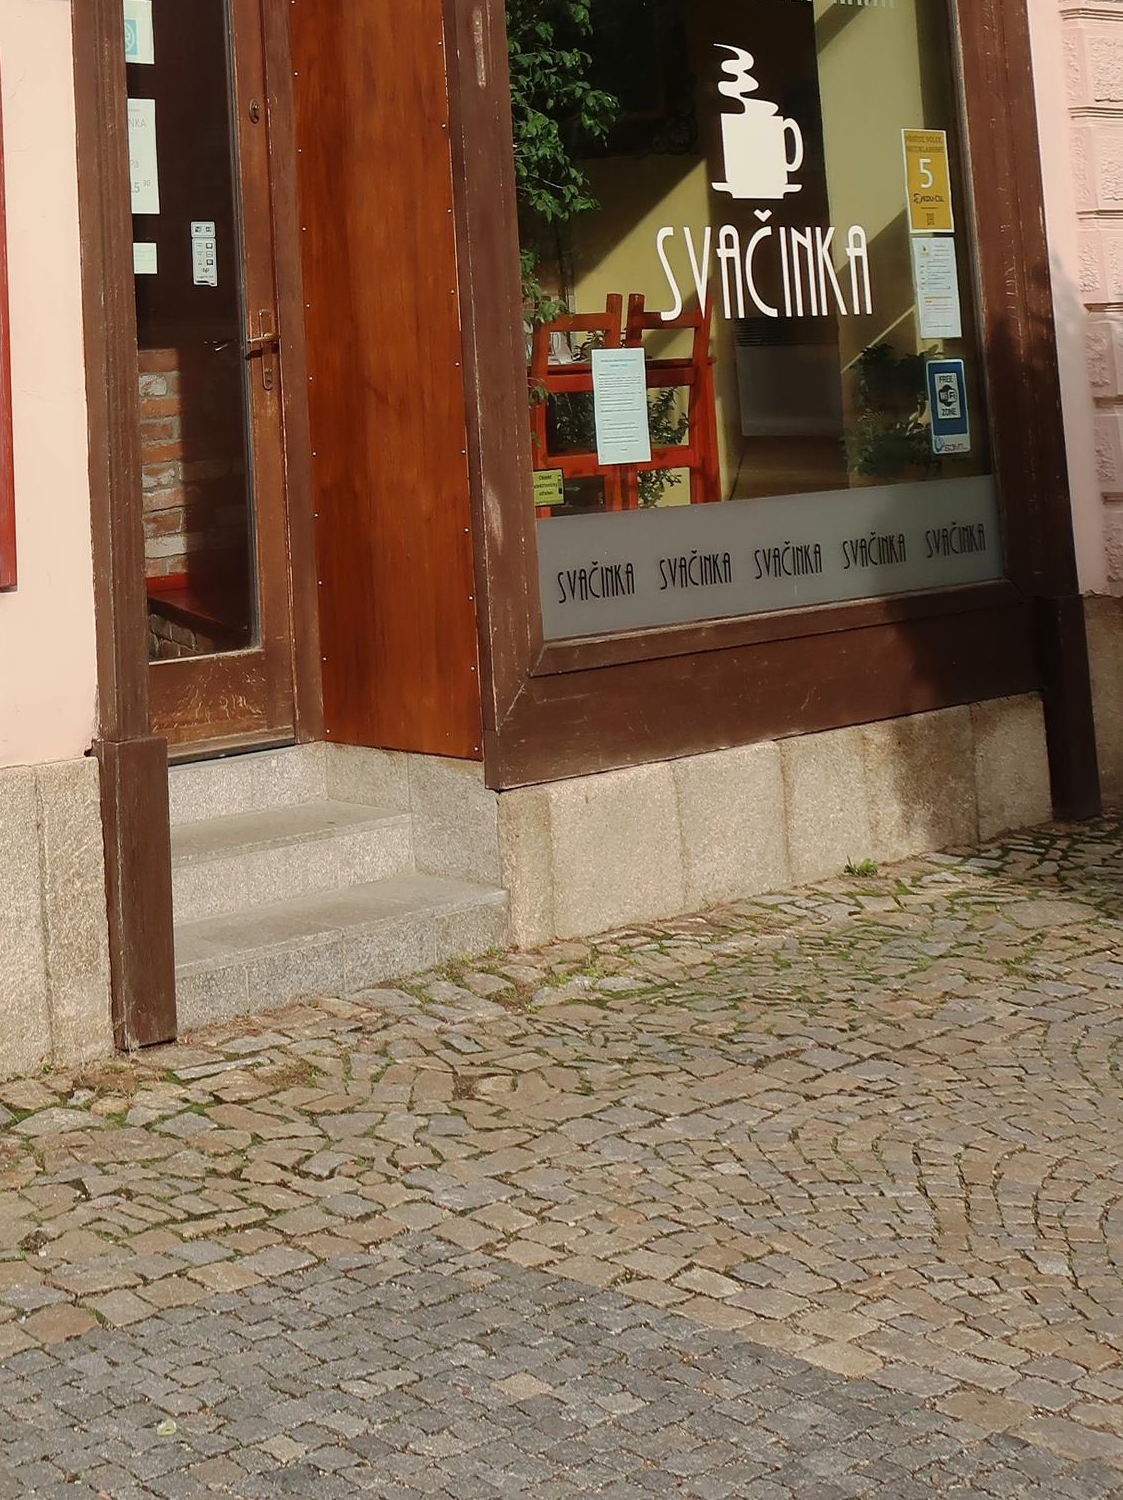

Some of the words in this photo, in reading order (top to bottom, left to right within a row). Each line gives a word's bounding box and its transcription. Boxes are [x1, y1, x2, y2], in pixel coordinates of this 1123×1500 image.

[919, 158, 934, 189] 5
[657, 209, 872, 321] SVAČINKA
[558, 561, 635, 604] SVAČINKA
[659, 550, 732, 590] SVAČINKA
[754, 541, 823, 580] SVAČINKA
[842, 532, 908, 570] SVAČINKA
[926, 522, 987, 559] SVAČINKA
